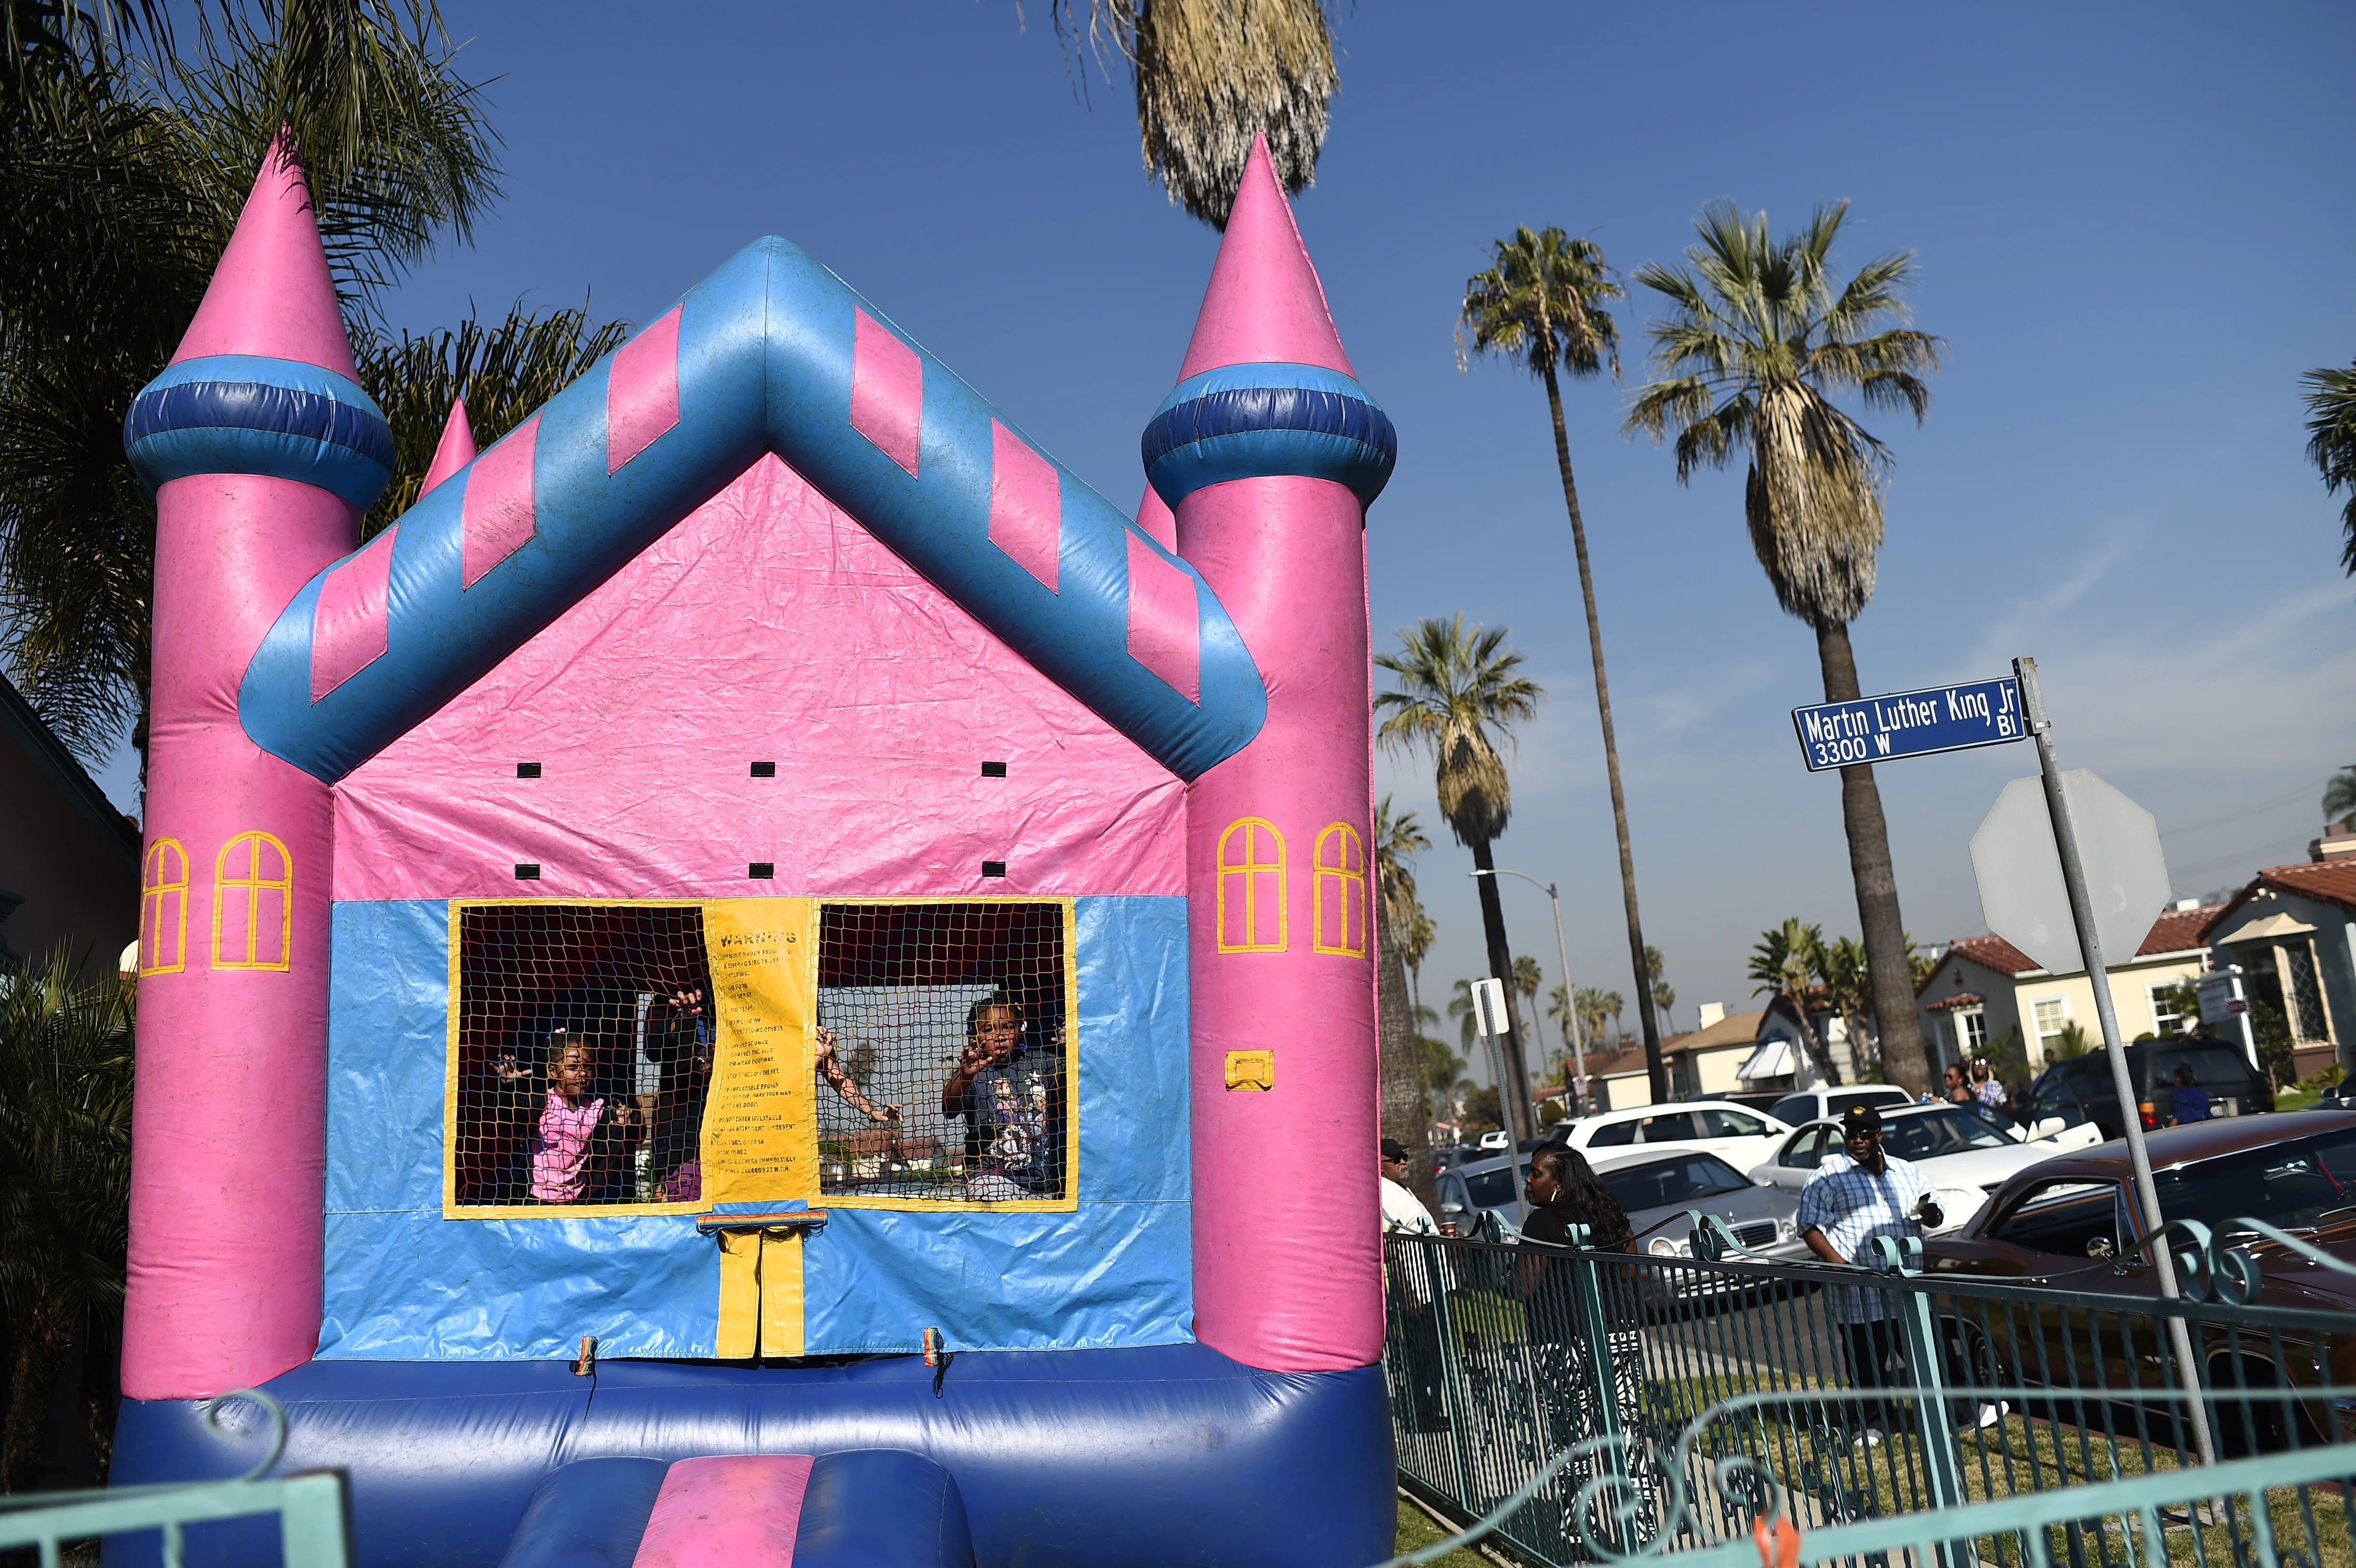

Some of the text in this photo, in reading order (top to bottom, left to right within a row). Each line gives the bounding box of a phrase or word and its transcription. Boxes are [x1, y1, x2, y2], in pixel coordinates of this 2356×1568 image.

[1804, 683, 2014, 743] Martin Luther King Jr
[1815, 733, 1891, 765] 3300 W
[744, 958, 767, 967] OBJECTS
